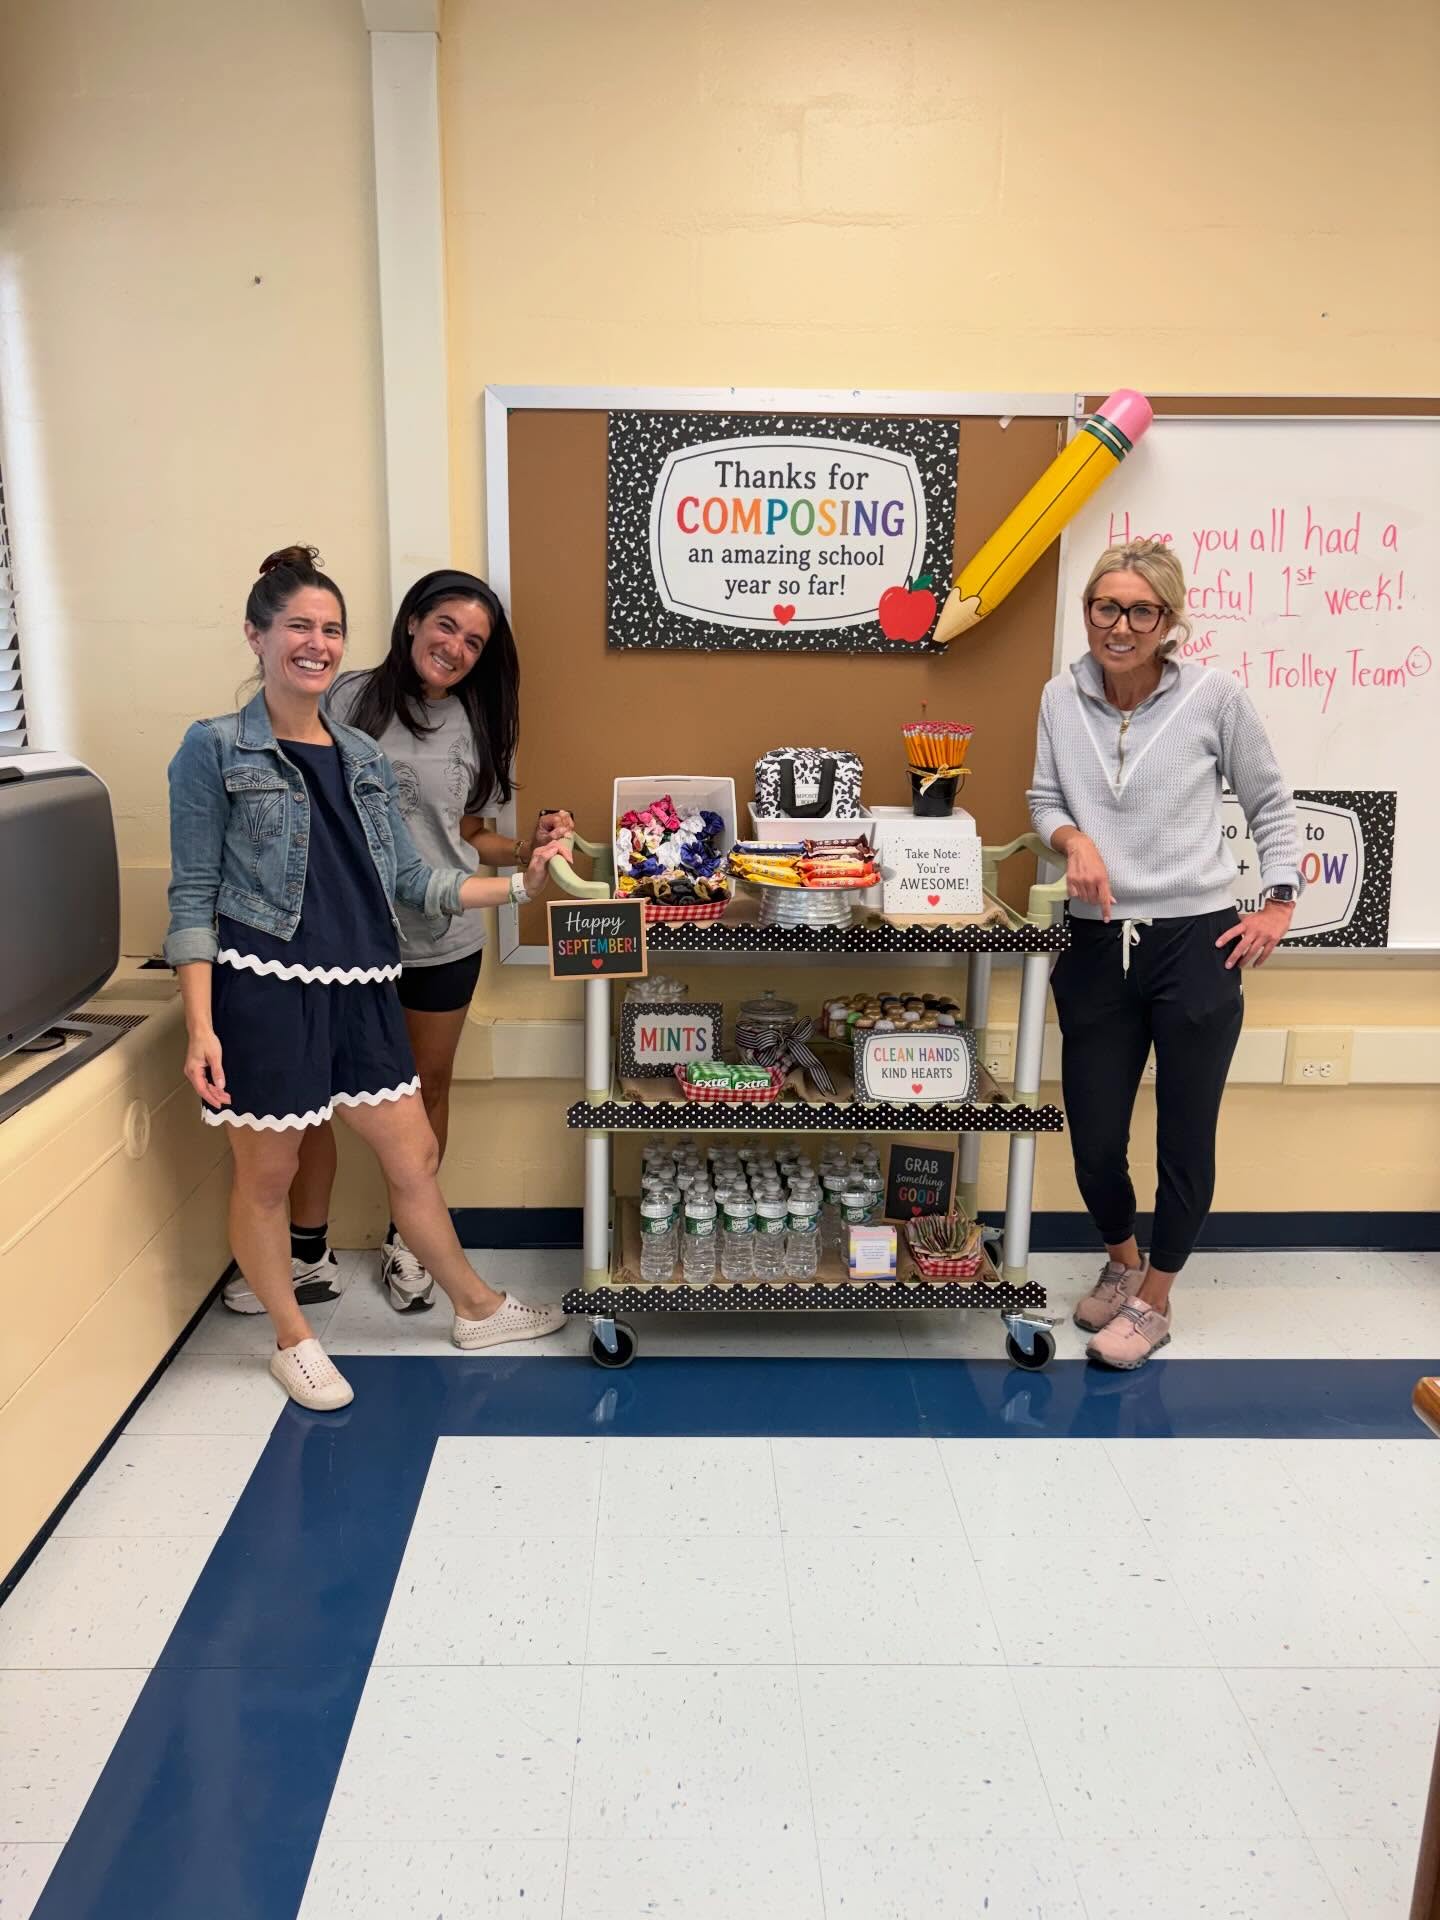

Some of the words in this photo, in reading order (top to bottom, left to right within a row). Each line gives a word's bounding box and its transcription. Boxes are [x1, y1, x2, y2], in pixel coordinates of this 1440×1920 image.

[714, 460, 816, 490] Thanks
[828, 463, 869, 490] for
[676, 496, 905, 537] COMPOSING
[1192, 528, 1239, 575] you
[1250, 508, 1285, 553] all
[1304, 505, 1361, 556] had
[1382, 523, 1398, 552] a
[688, 547, 714, 563] an
[721, 545, 811, 570] amazing
[818, 545, 885, 566] school
[725, 576, 771, 600] year
[778, 578, 801, 595] so
[808, 574, 846, 596] far!
[1280, 565, 1317, 617] 1st
[1325, 570, 1405, 616] week!
[1180, 630, 1216, 659] our
[1261, 649, 1338, 714] Trolley
[1346, 648, 1407, 689] Team
[1306, 823, 1325, 841] to
[905, 848, 930, 859] Take
[933, 848, 961, 859] Note:
[917, 862, 950, 874] You're
[899, 878, 969, 890] AWESOME!
[1236, 892, 1263, 912] ou!
[565, 911, 625, 935] Happy
[558, 937, 637, 956] SEPTEMBER!
[640, 1027, 707, 1052] MINTS
[873, 1047, 914, 1062] CLEAN
[918, 1047, 960, 1062] HANDS
[694, 1077, 730, 1088] Extra
[881, 1067, 907, 1079] KIND
[911, 1067, 953, 1079] HEARTS
[734, 1079, 769, 1090] Extra
[905, 1157, 939, 1174] GRAB
[896, 1174, 945, 1191] something
[898, 1186, 940, 1206] GOOD!
